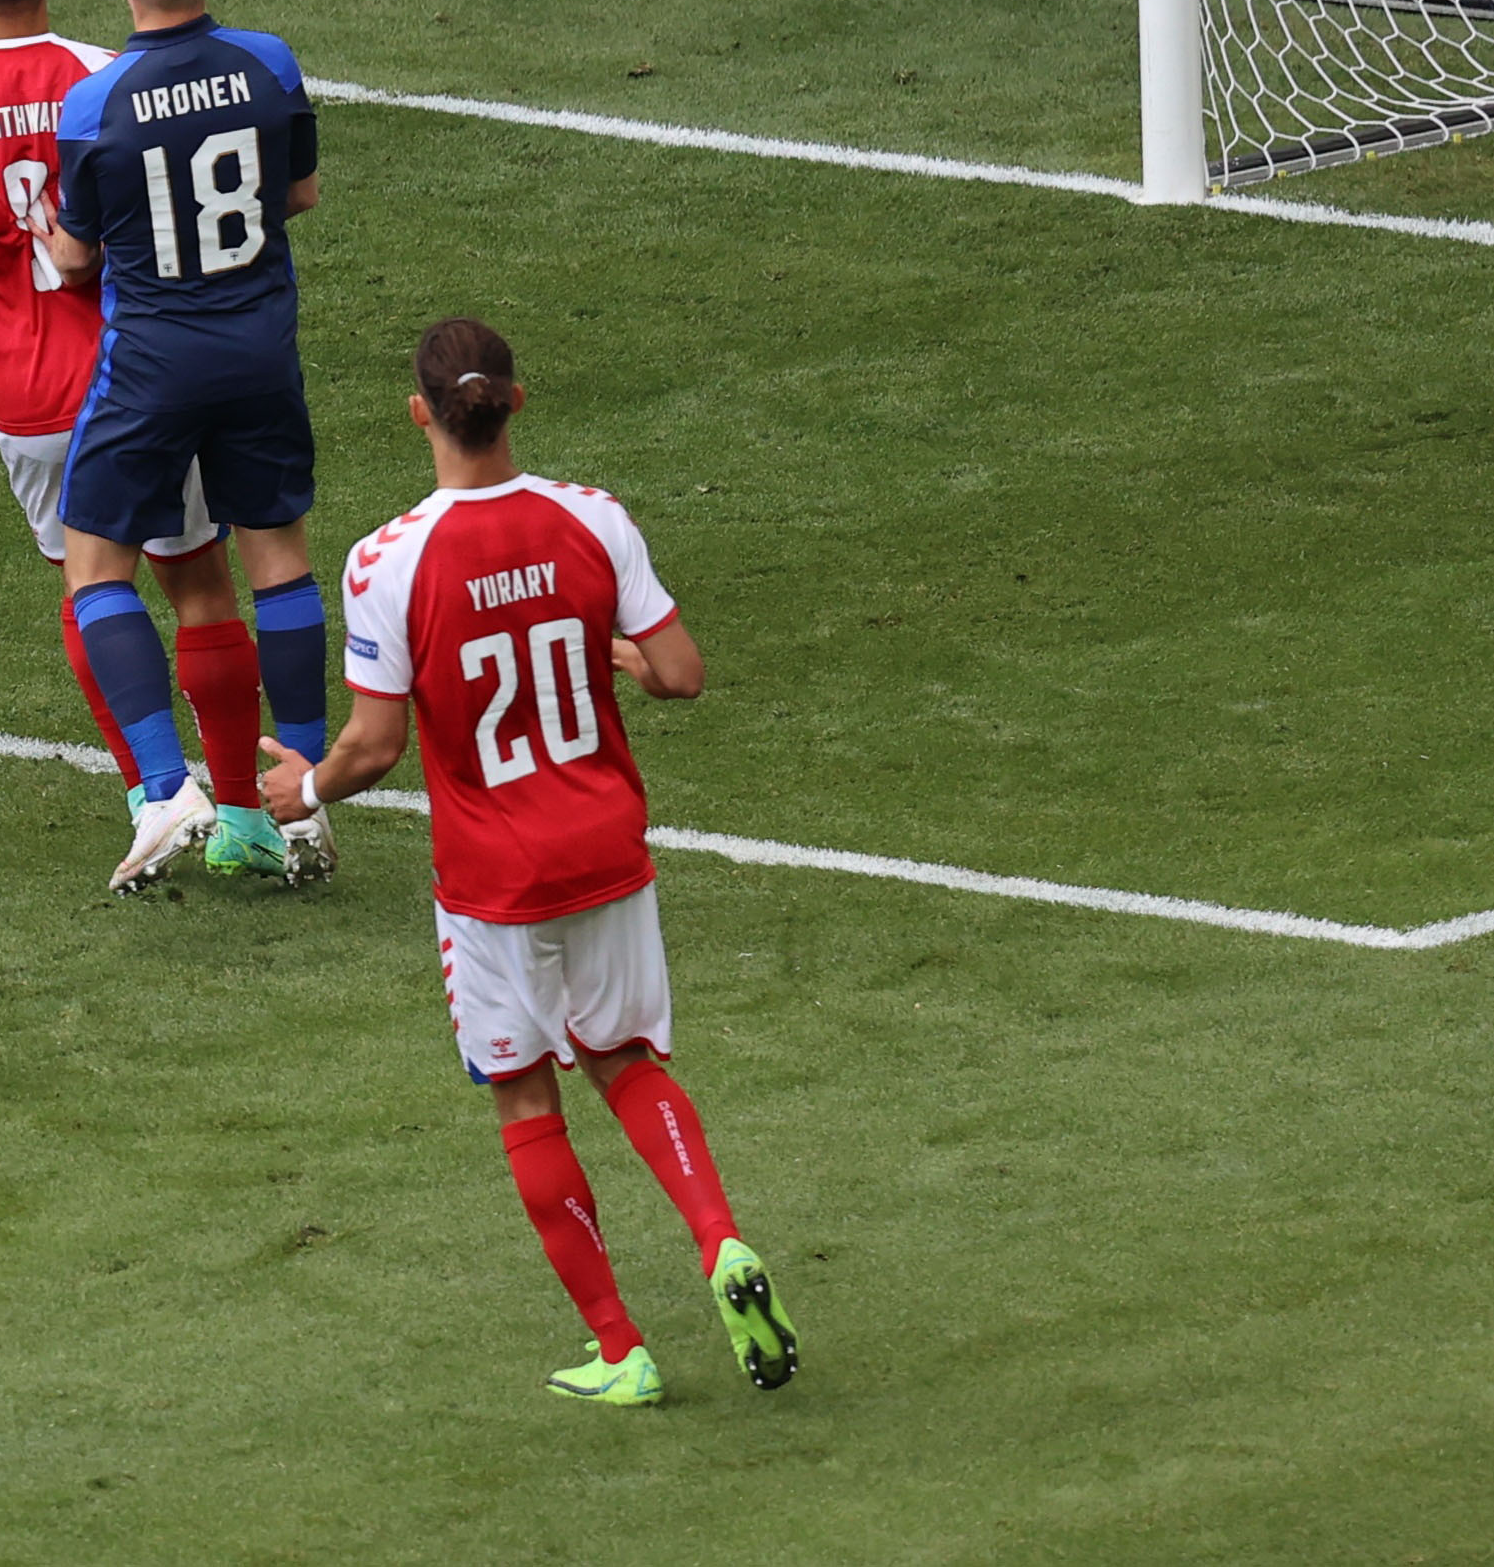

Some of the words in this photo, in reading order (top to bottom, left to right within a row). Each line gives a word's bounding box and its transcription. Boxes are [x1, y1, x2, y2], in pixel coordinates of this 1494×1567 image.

[131, 71, 252, 124] URONEN
[142, 126, 266, 280] 18
[465, 560, 557, 612] YURARY
[459, 616, 600, 790] 20
